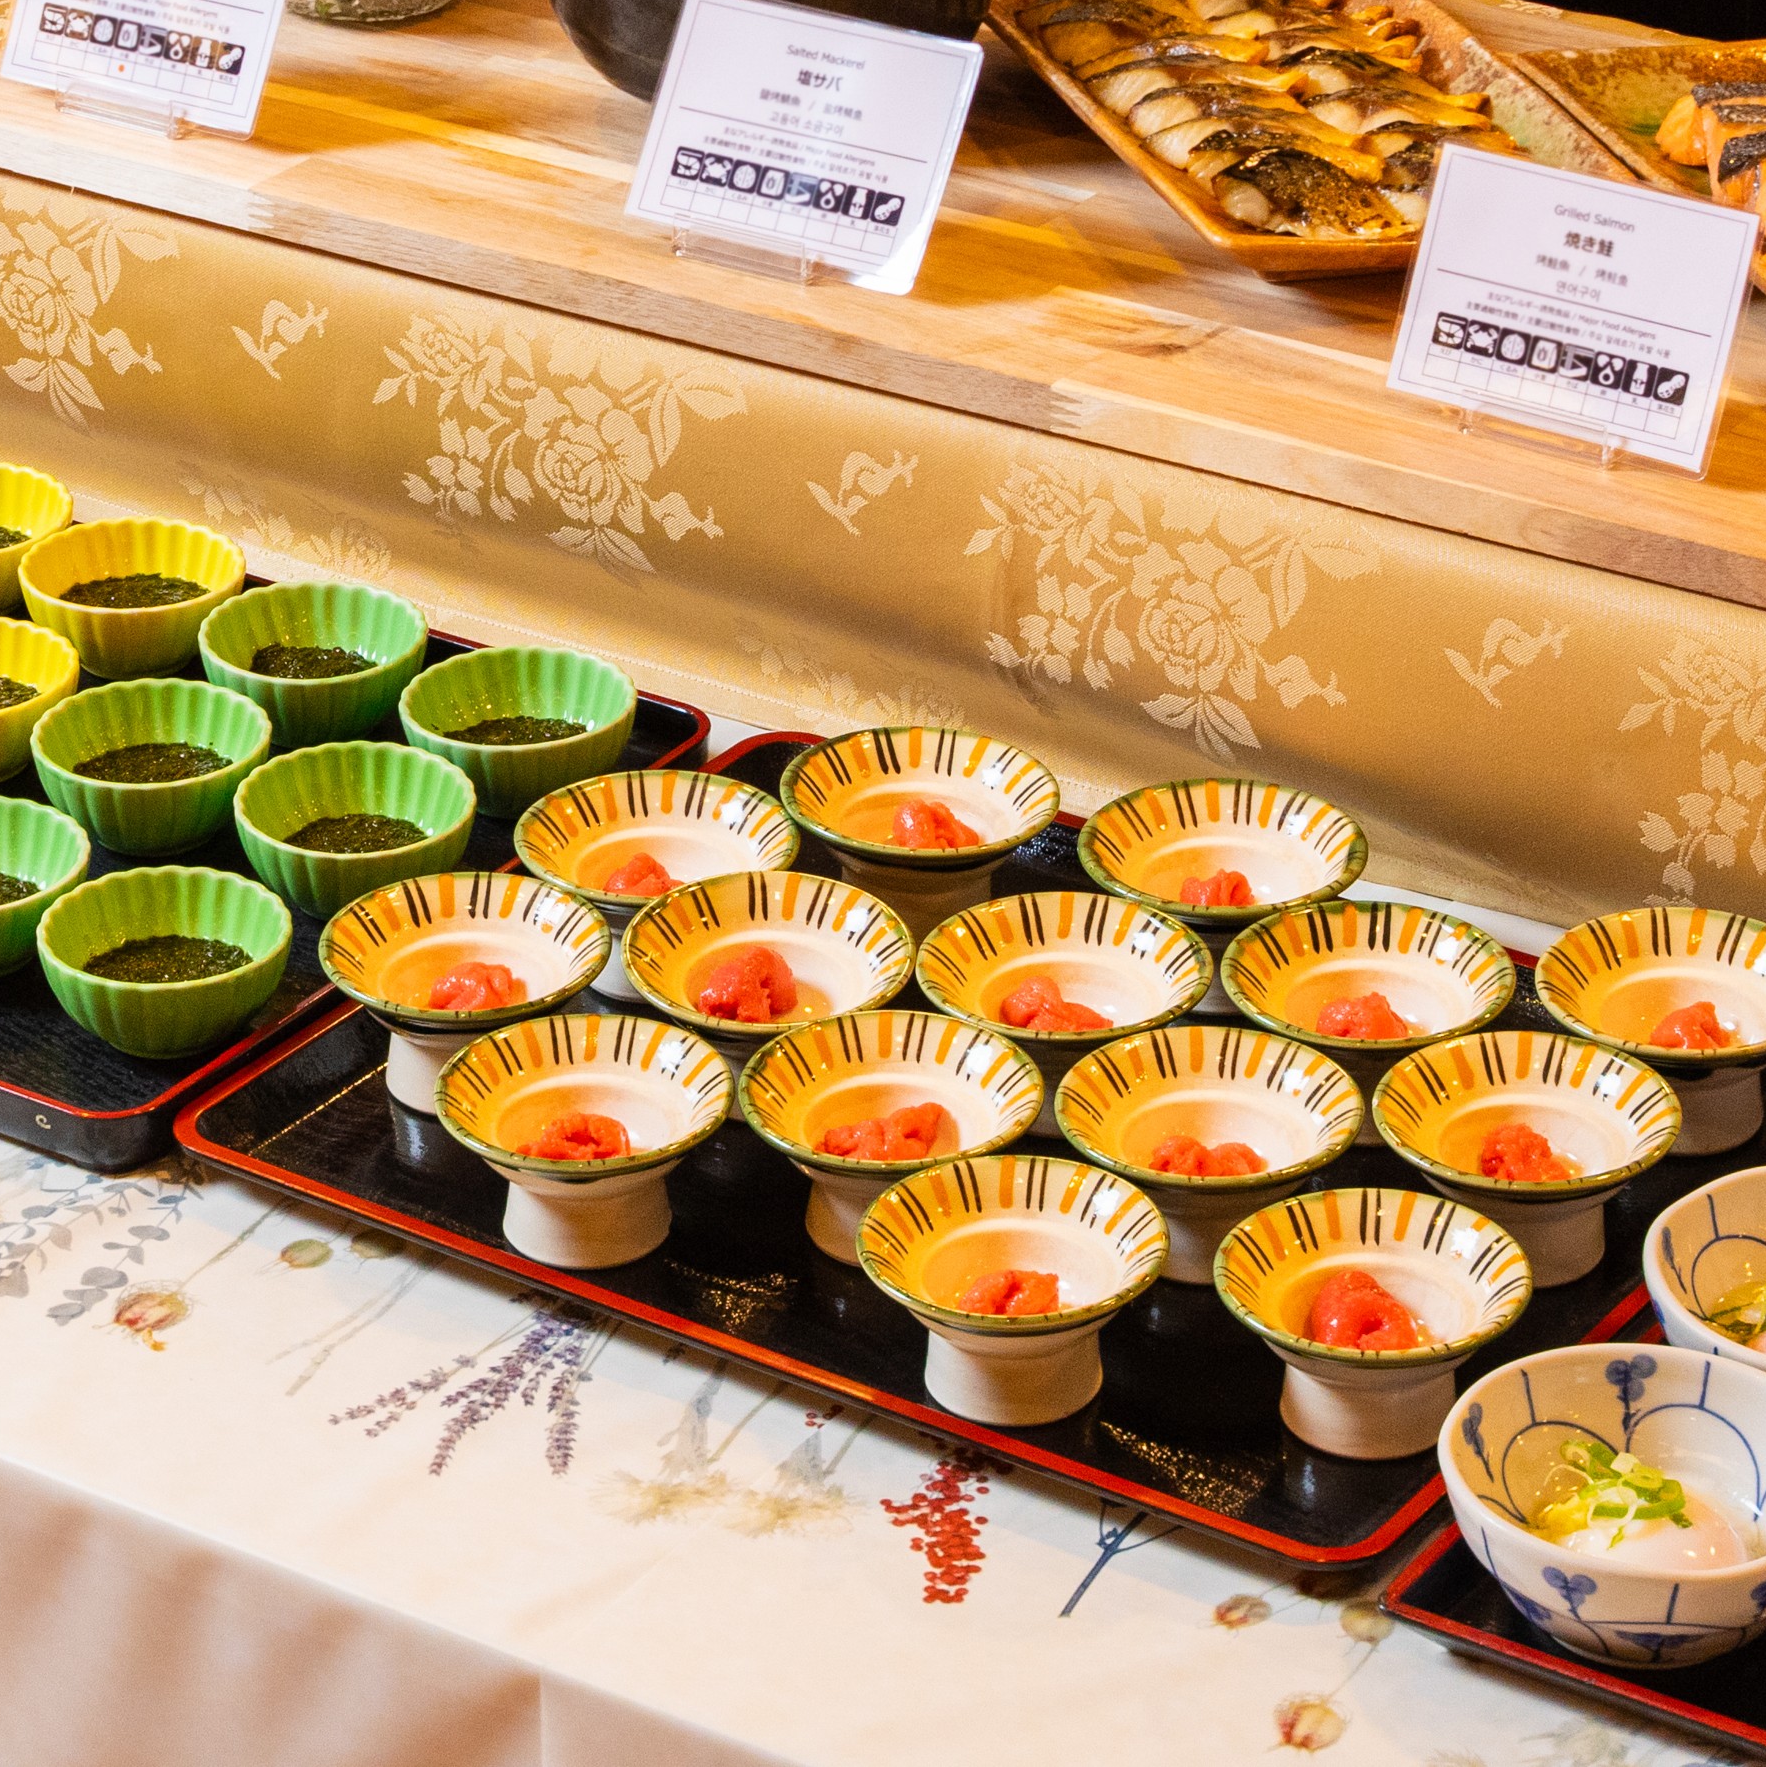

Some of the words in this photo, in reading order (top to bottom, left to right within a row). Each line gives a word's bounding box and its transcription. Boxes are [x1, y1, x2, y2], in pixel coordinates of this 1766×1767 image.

[787, 44, 818, 60] Salted
[821, 52, 865, 69] Mackerel
[797, 69, 840, 90] 塩サバ
[1554, 204, 1590, 222] Grilled
[1593, 213, 1634, 231] Salmon
[1565, 231, 1613, 257] 焼き鮭
